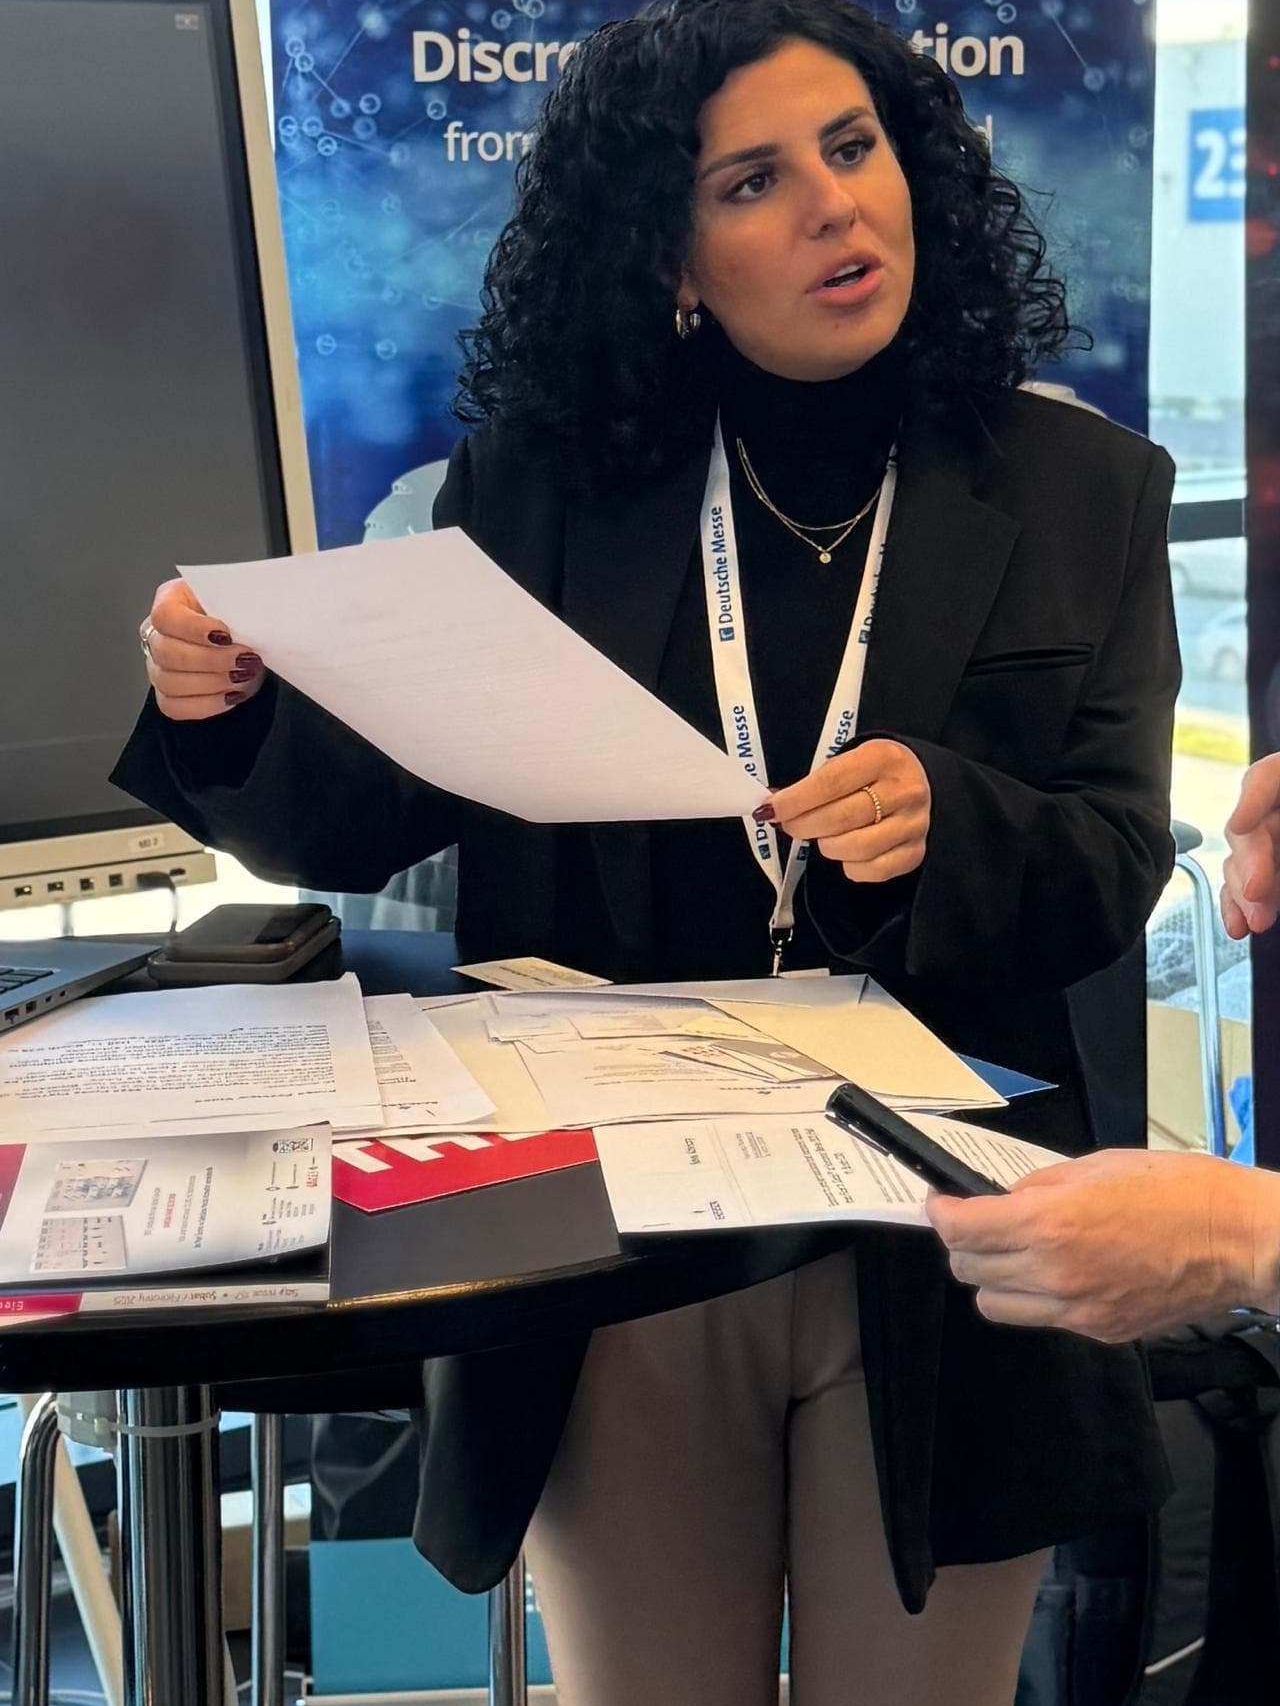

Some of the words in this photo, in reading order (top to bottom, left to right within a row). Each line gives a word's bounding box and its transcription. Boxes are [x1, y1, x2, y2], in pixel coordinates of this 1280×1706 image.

[411, 27, 577, 85] Discr
[710, 505, 726, 553] Messe
[713, 556, 733, 624] Deutsche
[733, 704, 754, 759] Messe
